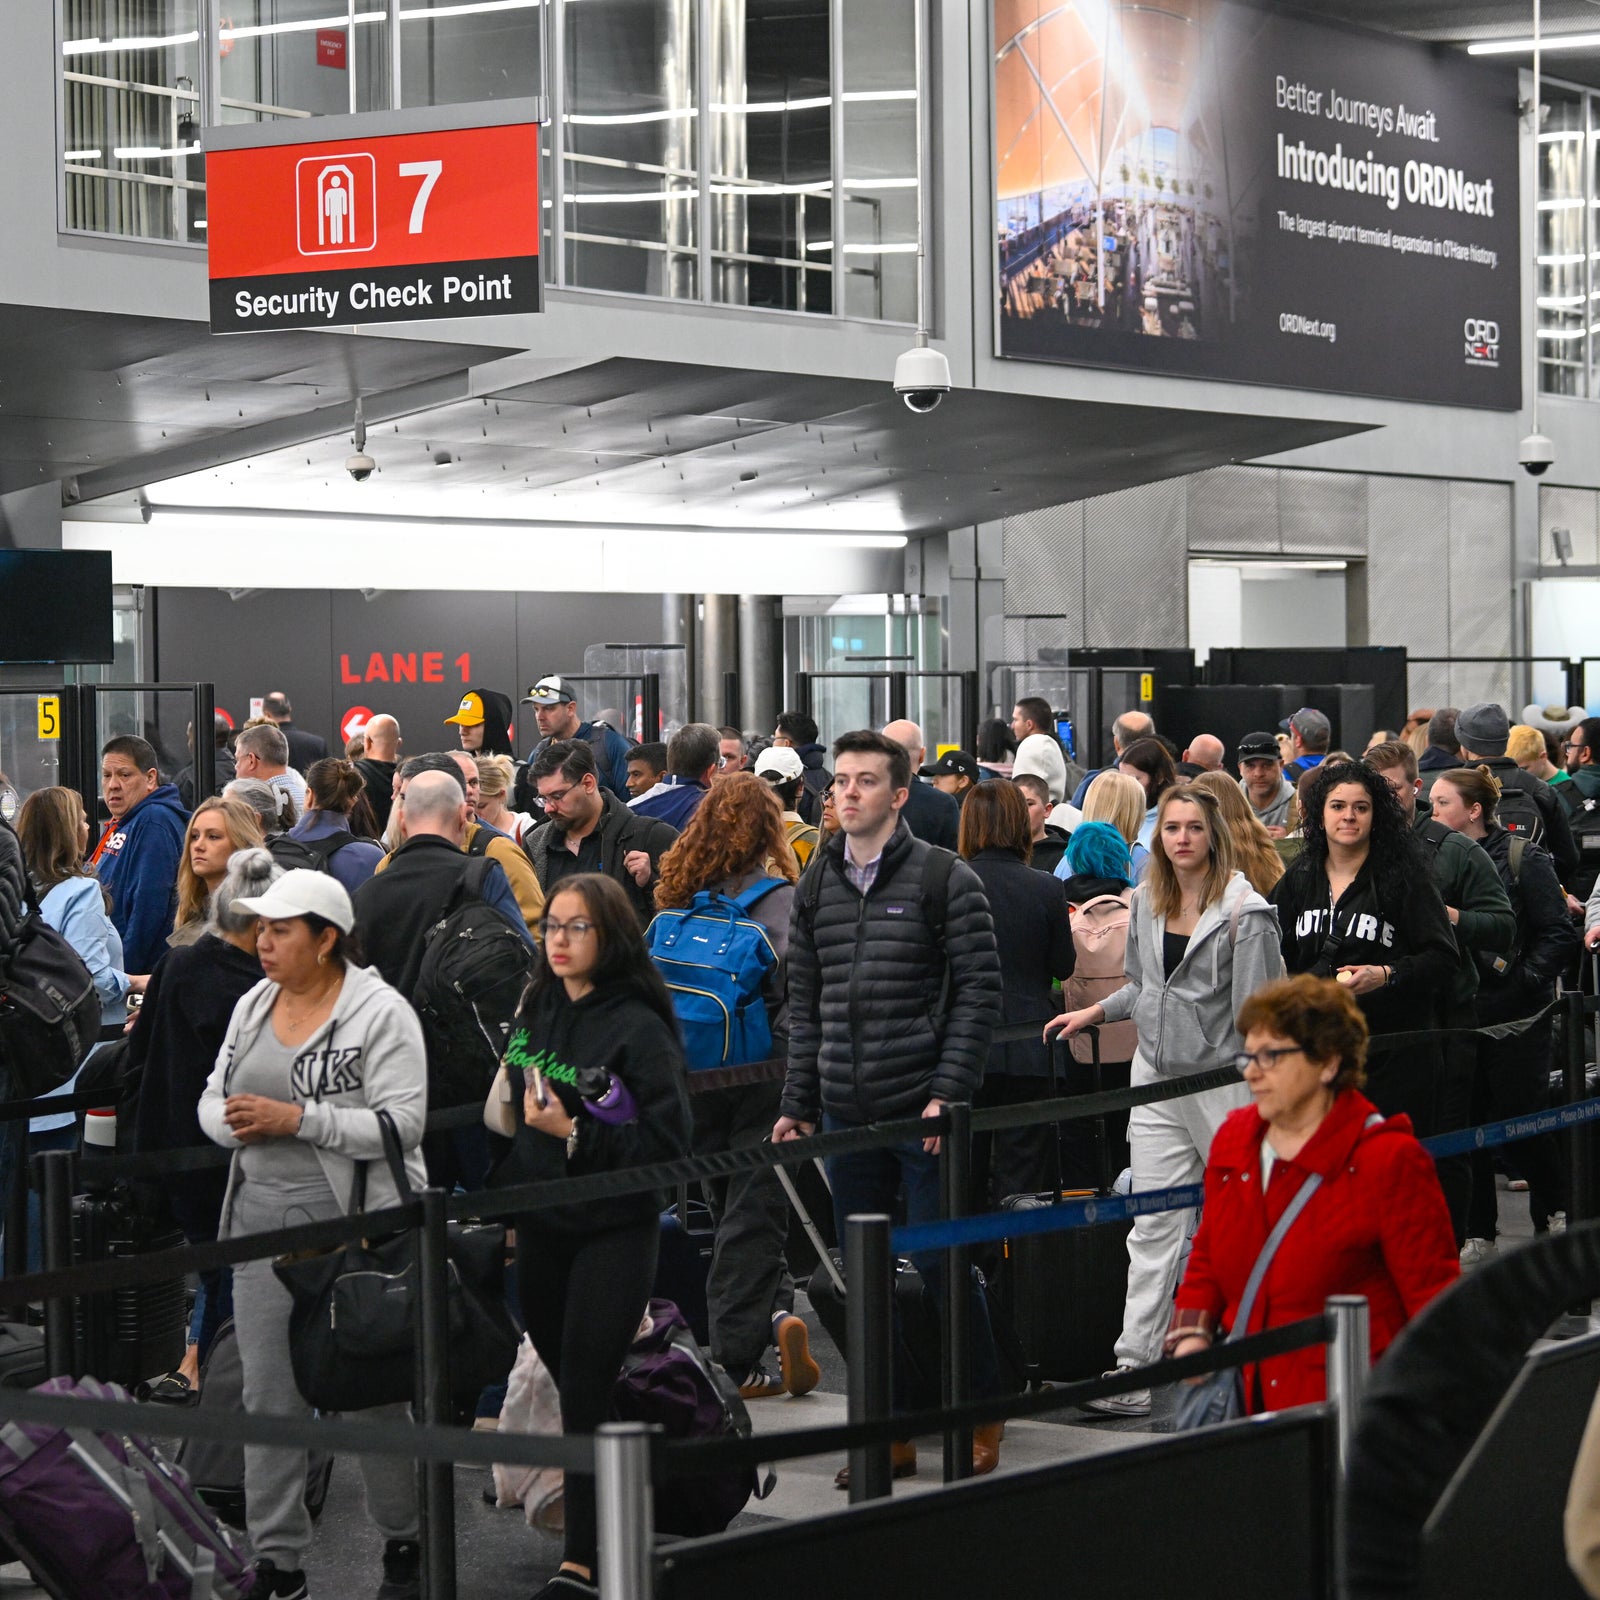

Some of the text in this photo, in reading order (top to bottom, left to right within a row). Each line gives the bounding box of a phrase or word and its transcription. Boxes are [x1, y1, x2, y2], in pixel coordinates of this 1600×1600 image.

[1276, 75, 1441, 143] Better Journeys Await.
[1277, 133, 1494, 218] Introducing ORDNext
[398, 159, 443, 235] 7
[1277, 211, 1296, 232] The
[1296, 213, 1327, 240] largest
[1328, 220, 1357, 244] airport
[1357, 226, 1392, 248] terminal
[1392, 234, 1433, 255] expansion
[1434, 237, 1443, 256] in
[1443, 239, 1470, 261] O'Hare
[235, 274, 512, 319] Security Check Point
[1279, 313, 1337, 343] ORDNext.org
[1464, 318, 1500, 344] ORD
[340, 651, 471, 684] LANE 1
[42, 701, 56, 735] 5
[1505, 1123, 1517, 1137] TSA
